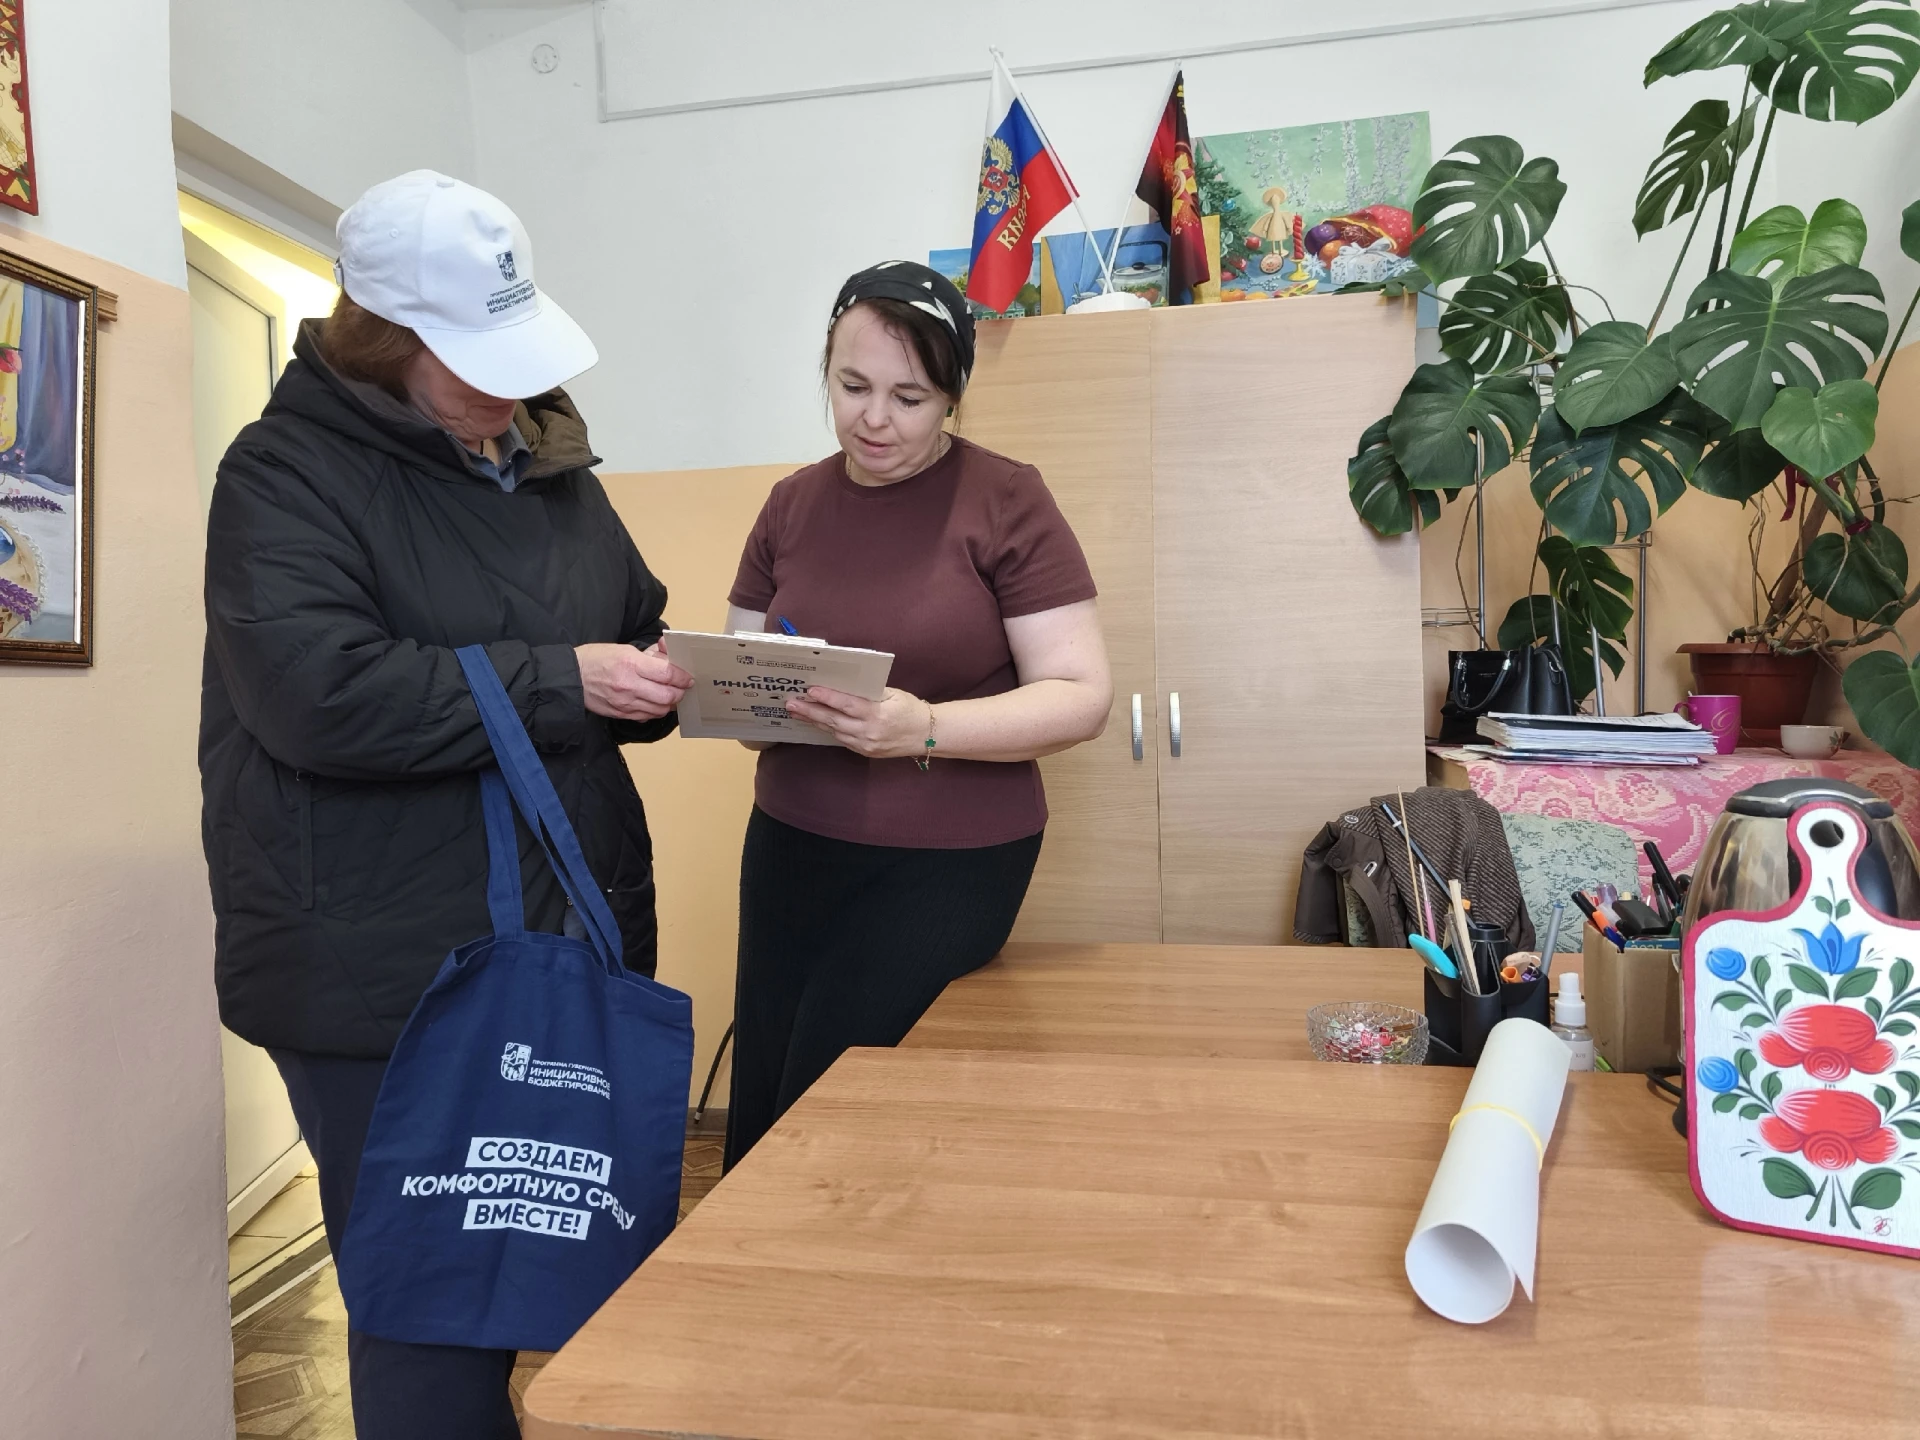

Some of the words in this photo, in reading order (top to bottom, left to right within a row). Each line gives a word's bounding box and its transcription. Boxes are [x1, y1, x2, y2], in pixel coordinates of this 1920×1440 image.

[486, 282, 534, 307] ИНИЦИАТИВНОЕ
[713, 679, 809, 693] ИНИЦИАТ
[747, 675, 806, 685] СБОР
[530, 1067, 611, 1091] ИНИЦИАТИВНОЕ
[532, 1059, 567, 1068] ПРОГРАММА
[568, 1063, 604, 1075] ГУБЕРНАТОРА
[528, 1077, 610, 1100] БЮДЖЕТИРОВАНИЕ
[478, 1141, 604, 1177] СОЗДАЕМ
[401, 1173, 581, 1203] КОМФОРТНУЮ
[585, 1187, 636, 1230] СРЕДУ
[473, 1203, 581, 1234] ВМЕСТЕ!
